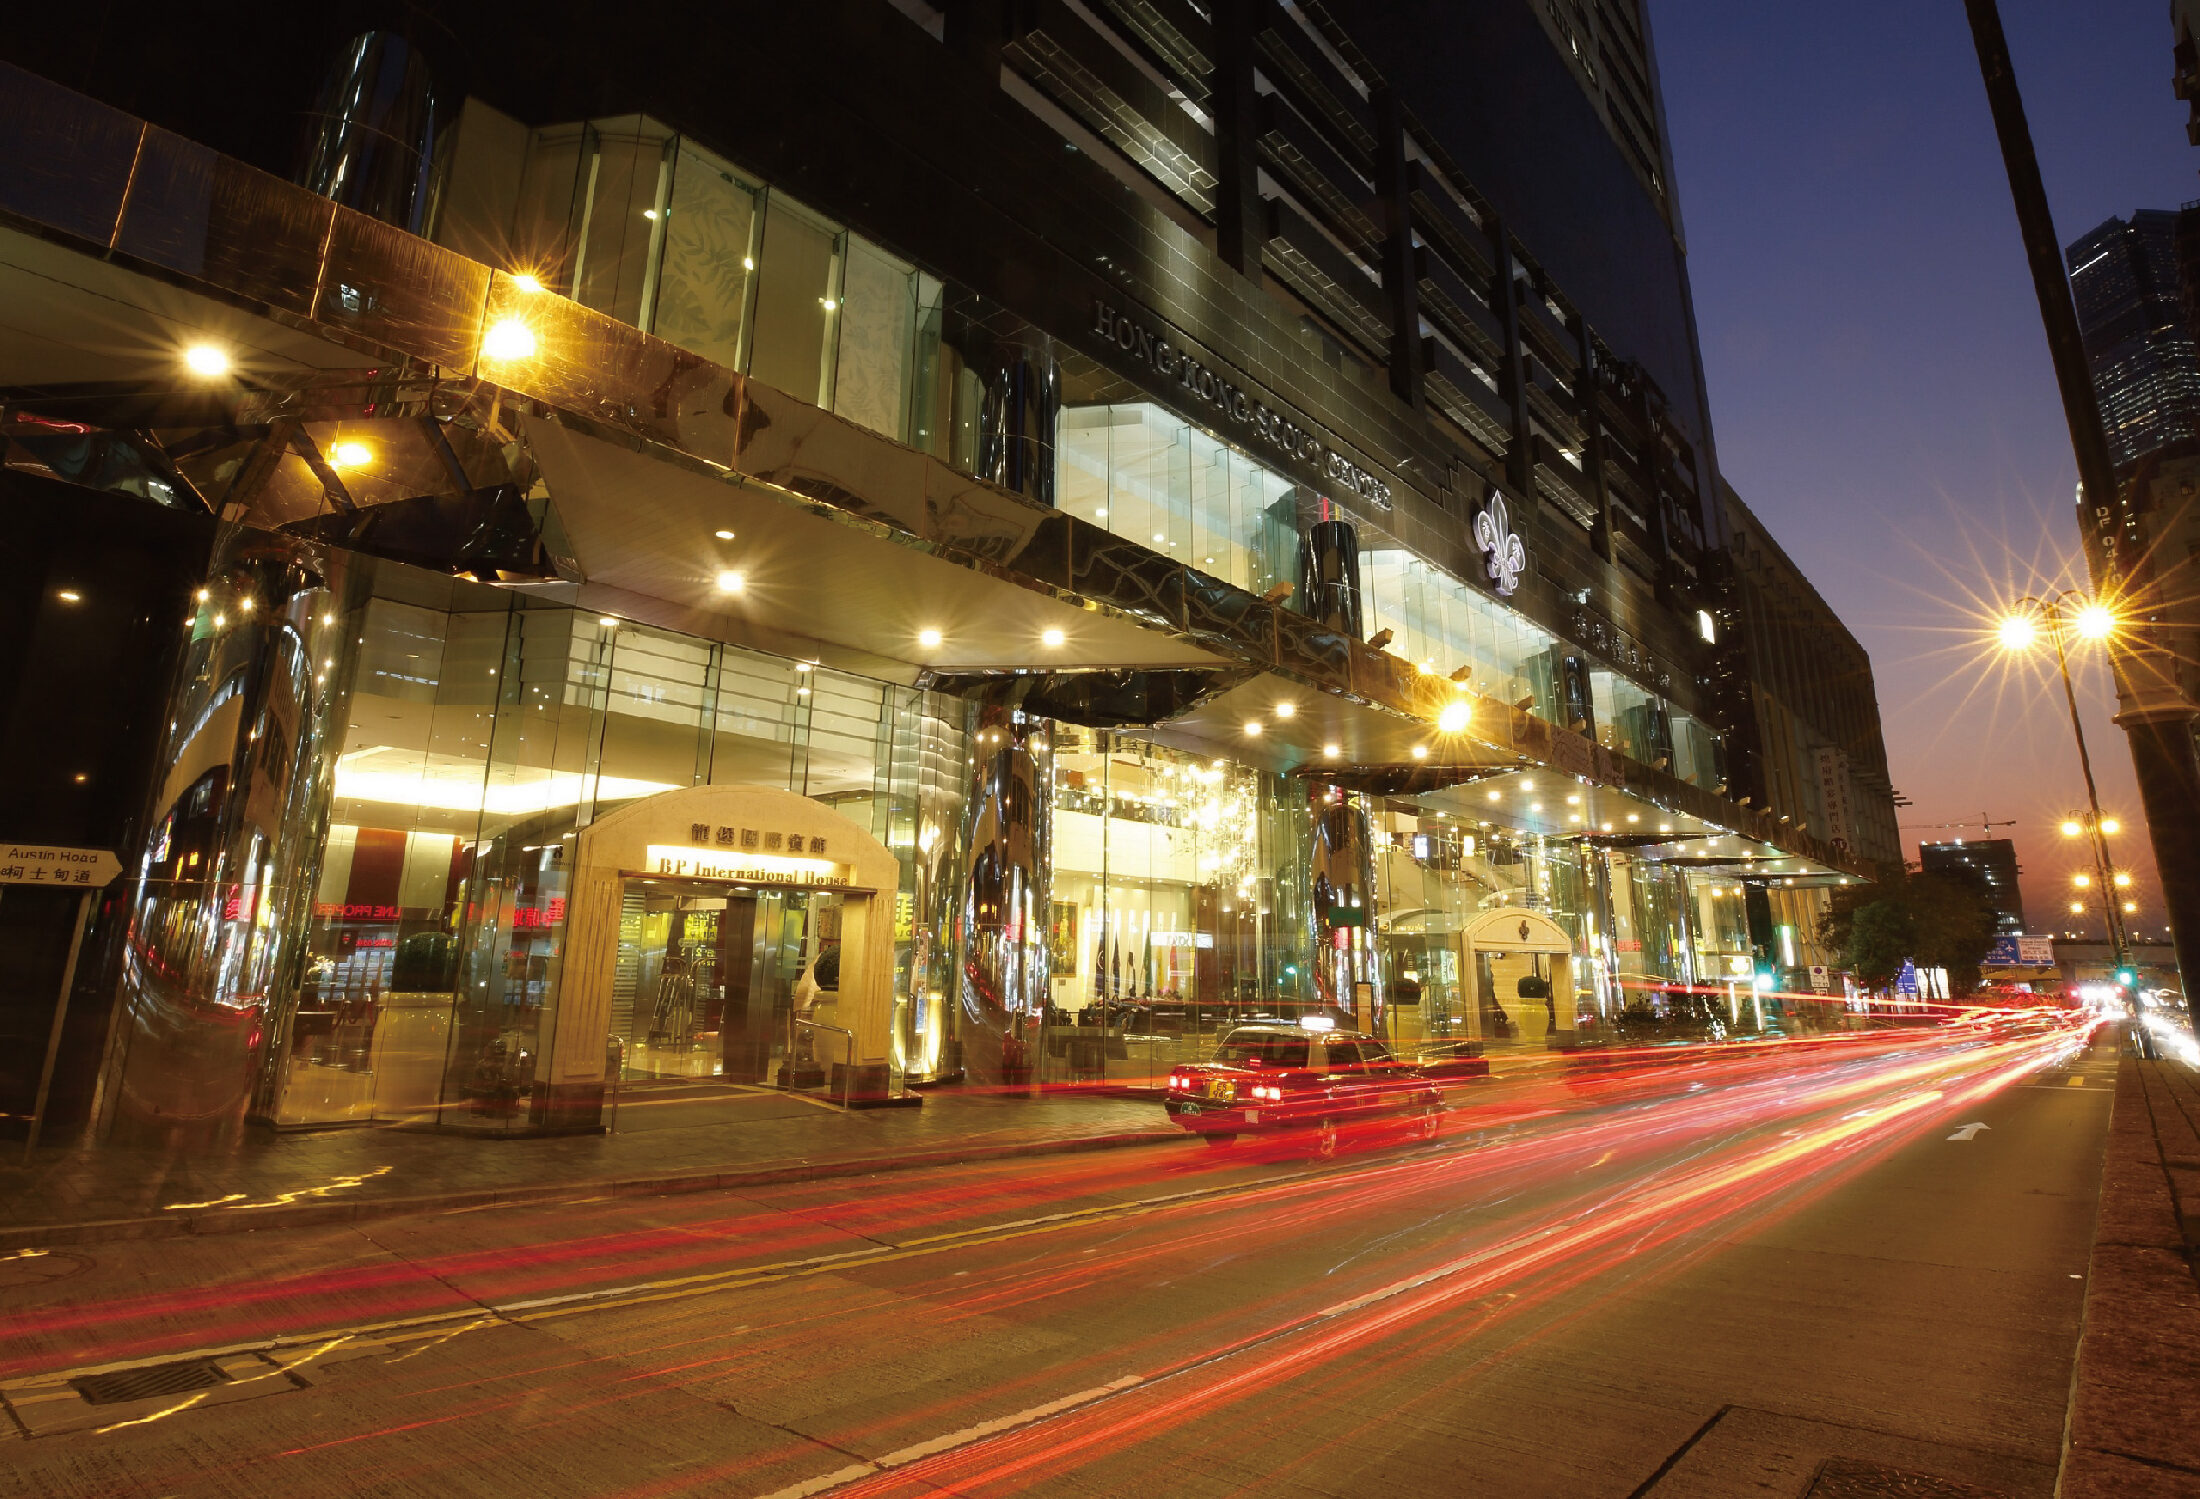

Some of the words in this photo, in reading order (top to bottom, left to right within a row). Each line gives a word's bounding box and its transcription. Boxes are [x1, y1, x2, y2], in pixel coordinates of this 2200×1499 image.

[1093, 299, 1174, 374] HONG
[1180, 355, 1252, 423] KONG
[1253, 403, 1322, 467] SCOUT
[1324, 450, 1393, 511] CENTRE
[8, 848, 55, 861] Austin
[60, 852, 98, 864] Road
[694, 861, 799, 883] International
[805, 871, 849, 886] House
